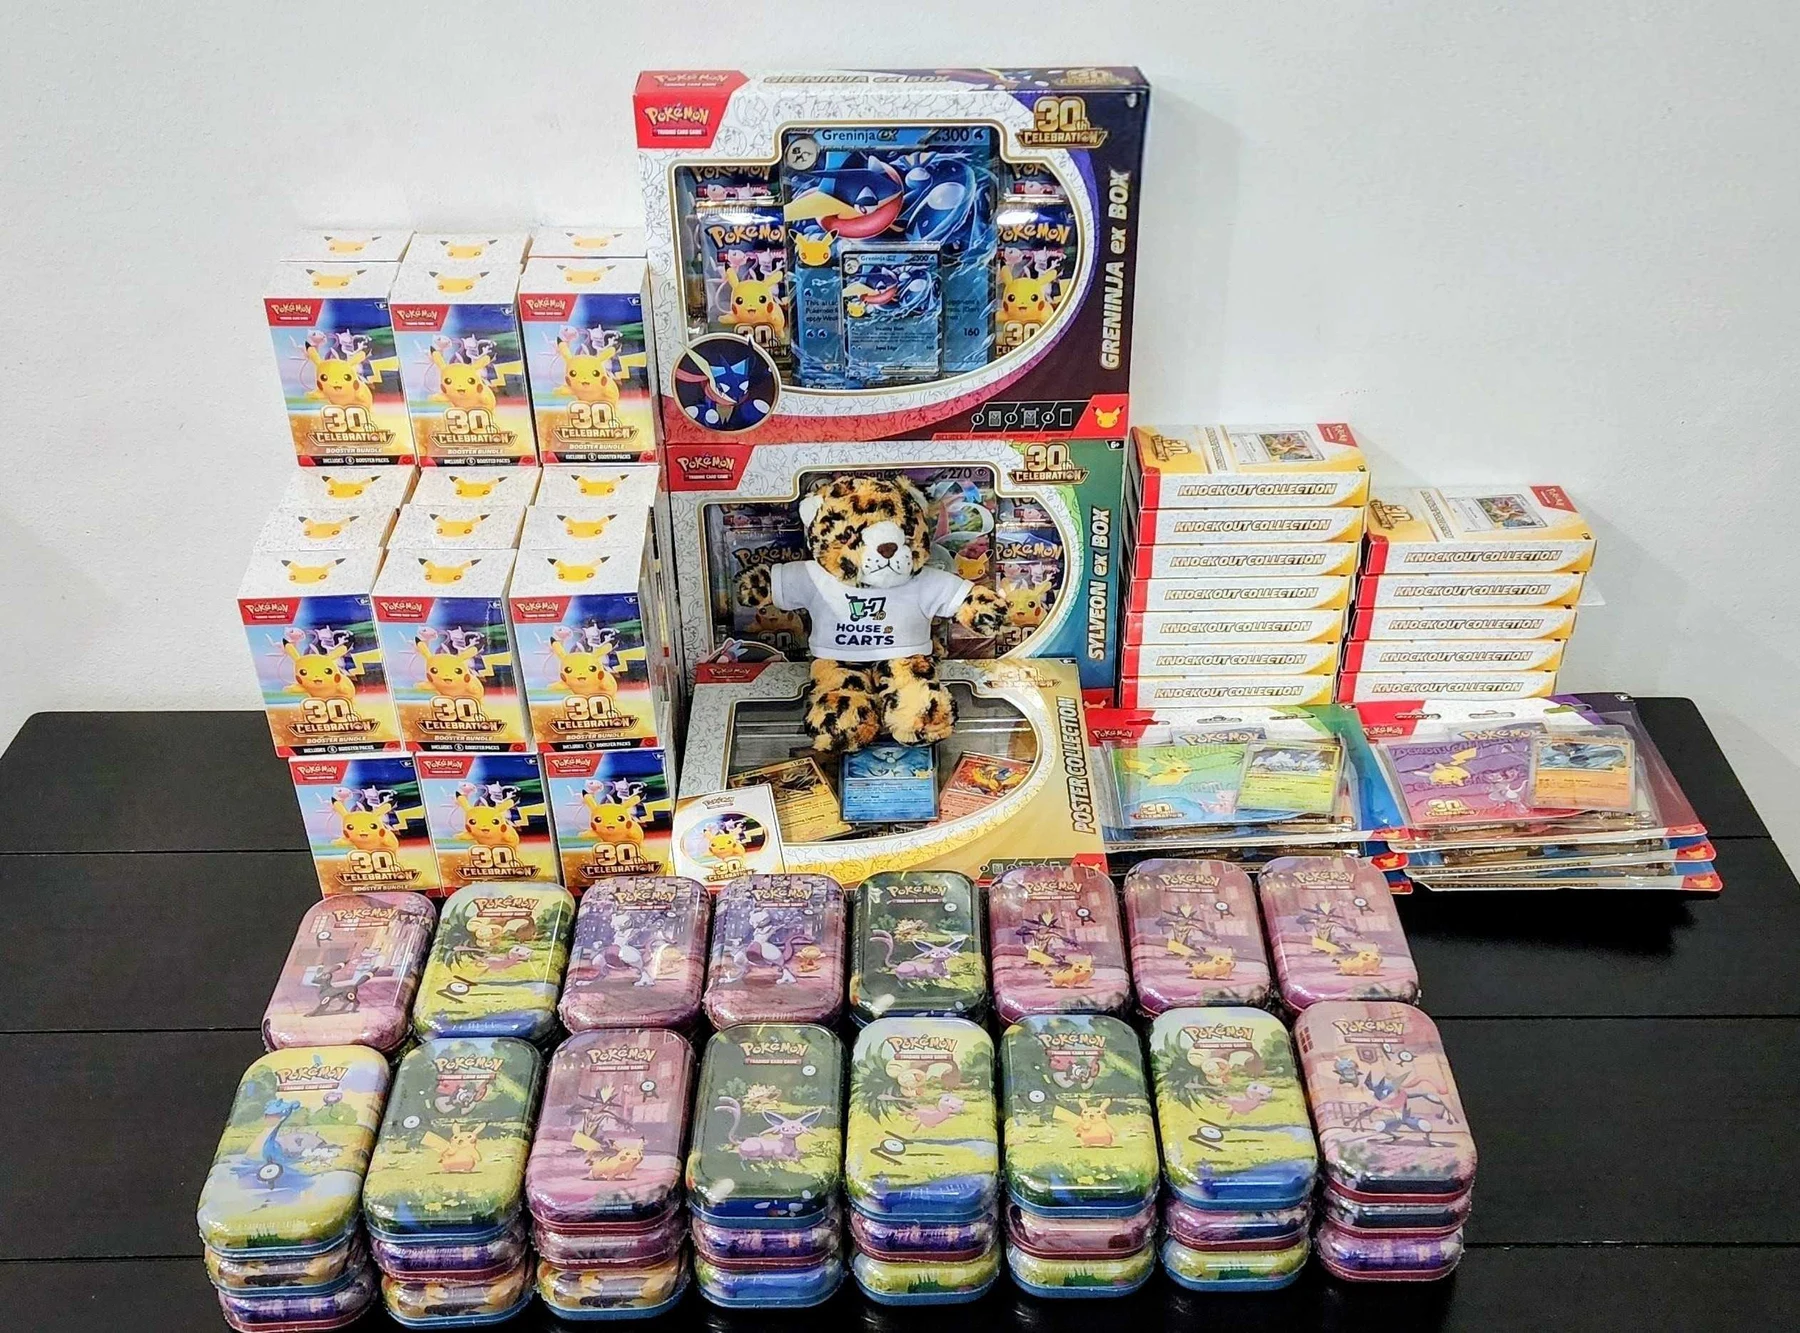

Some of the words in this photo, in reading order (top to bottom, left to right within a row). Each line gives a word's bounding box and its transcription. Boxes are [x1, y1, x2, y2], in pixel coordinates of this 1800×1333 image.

[822, 129, 877, 150] Greninja
[941, 129, 970, 143] 300
[1023, 130, 1101, 146] CELEBRATION
[1107, 169, 1131, 220] BOX
[1110, 226, 1126, 254] ex
[1101, 262, 1125, 370] GRENINJA
[963, 327, 980, 337] 160
[317, 432, 387, 443] CELEBRATION
[439, 432, 510, 444] CELEBRATION
[562, 427, 630, 438] CELEBRATION
[949, 468, 972, 479] 270
[1015, 470, 1082, 482] CELEBRATION
[1178, 484, 1226, 496] KNOCK
[1225, 484, 1256, 496] OUT
[1257, 482, 1338, 496] COLLECTION
[1091, 507, 1110, 549] BOX
[1174, 521, 1224, 533] KNOCK
[1222, 520, 1251, 532] OUT
[1251, 519, 1331, 531] COLLECTION
[1170, 556, 1218, 567] KNOCK
[1219, 555, 1247, 567] OUT
[1247, 554, 1326, 566] COLLECTION
[1404, 552, 1454, 563] KNOCK
[1451, 551, 1482, 562] OUT
[1482, 550, 1561, 562] COLLECTION
[1093, 553, 1108, 576] ex
[1165, 590, 1213, 601] KNOCK
[1213, 589, 1241, 600] OUT
[1240, 587, 1319, 599] COLLECTION
[1394, 586, 1443, 597] KNOCK
[1442, 586, 1471, 596] OUT
[1471, 584, 1550, 595] COLLECTION
[1088, 580, 1107, 661] SYLVEON
[1389, 620, 1436, 631] KNOCK
[1435, 620, 1464, 630] OUT
[1465, 618, 1543, 629] COLLECTION
[836, 623, 881, 633] HOUSE
[1160, 623, 1206, 634] KNOCK
[1206, 622, 1235, 633] OUT
[1235, 621, 1312, 632] COLLECTION
[835, 634, 895, 646] CARTS
[1156, 655, 1202, 666] KNOCK
[1202, 655, 1230, 665] OUT
[1230, 654, 1307, 665] COLLECTION
[1380, 652, 1427, 662] KNOCK
[1426, 652, 1455, 661] OUT
[1455, 651, 1533, 661] COLLECTION
[1155, 688, 1201, 699] KNOCK
[1200, 687, 1227, 698] OUT
[1228, 686, 1304, 697] COLLECTION
[1371, 683, 1419, 693] KNOCK
[1419, 682, 1447, 692] OUT
[1447, 682, 1522, 692] COLLECTION
[297, 722, 370, 733] CELEBRATION
[425, 720, 498, 731] CELEBRATION
[558, 718, 629, 729] CELEBRATION
[1057, 697, 1087, 778] COLLECTION
[1067, 777, 1096, 834] POSTER
[463, 866, 532, 876] CELEBRATION
[587, 863, 654, 875] CELEBRATION
[343, 871, 413, 882] CELEBRATION
